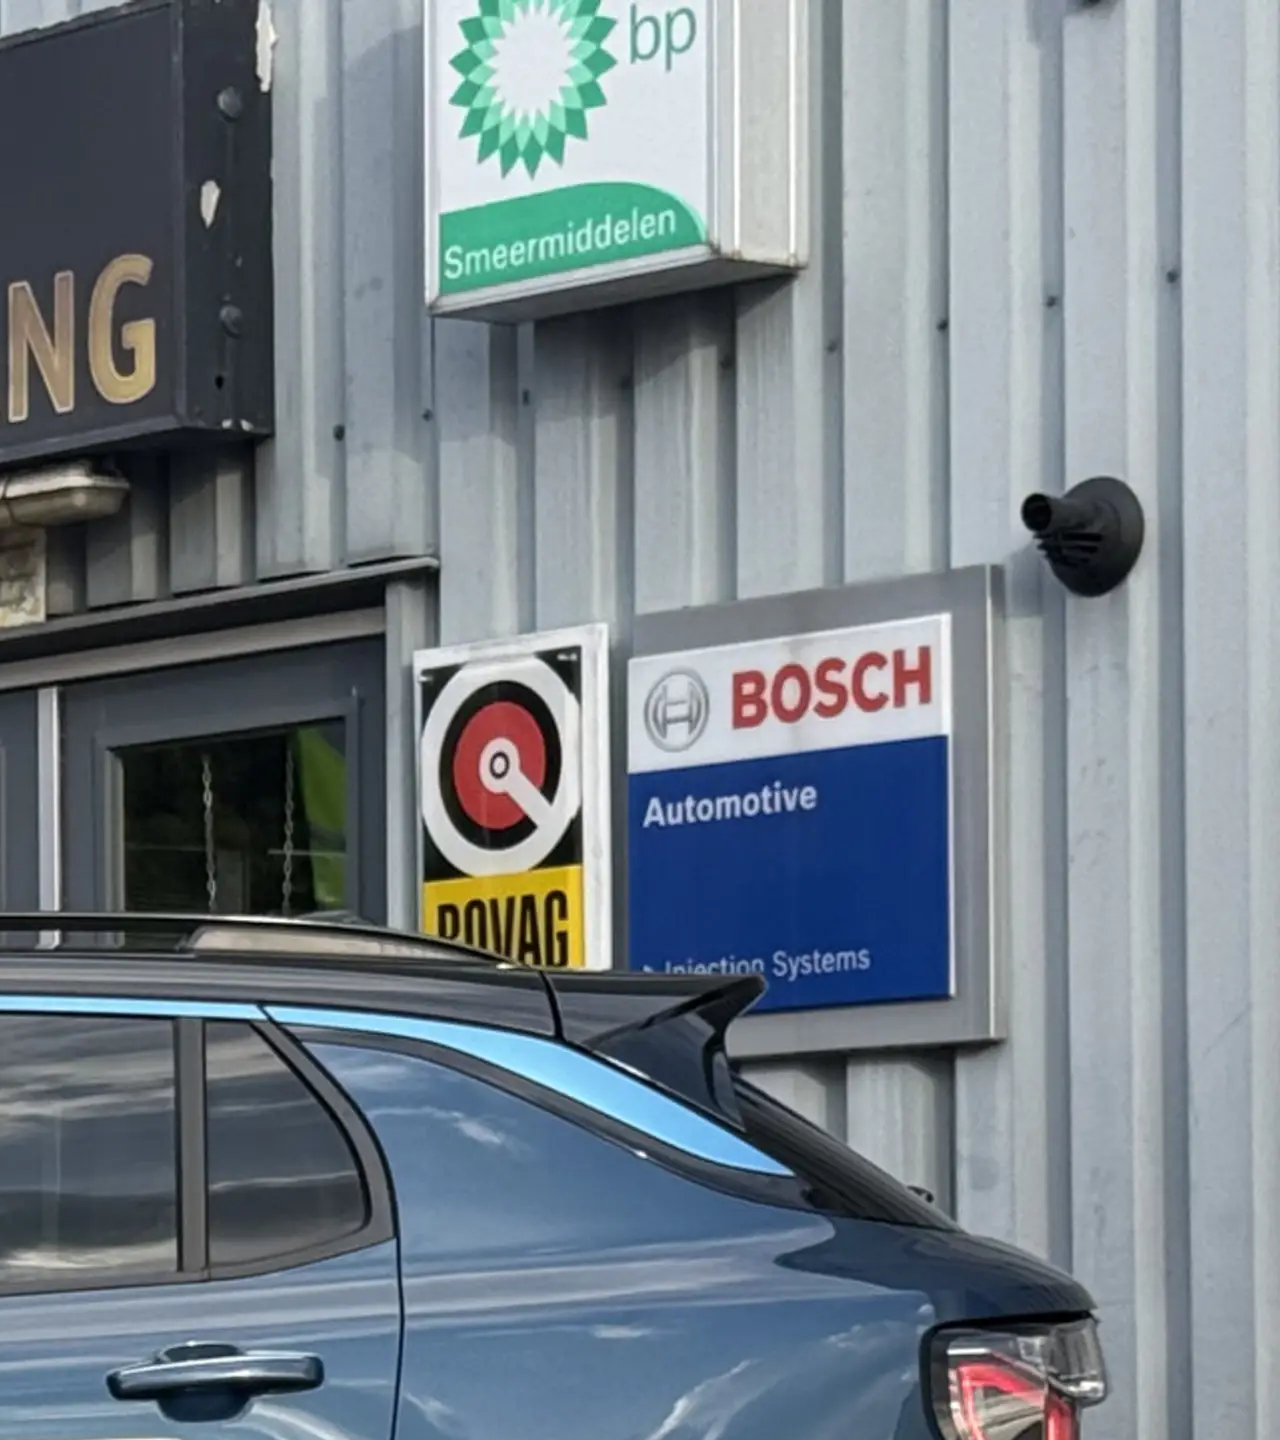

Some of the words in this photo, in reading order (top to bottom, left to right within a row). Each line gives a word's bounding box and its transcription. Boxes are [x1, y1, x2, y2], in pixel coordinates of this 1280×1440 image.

[630, 3, 697, 72] bp
[444, 205, 677, 280] Smeermiddelen
[731, 645, 932, 730] BOSCH
[643, 780, 818, 829] Automotive
[772, 949, 871, 981] Systems
